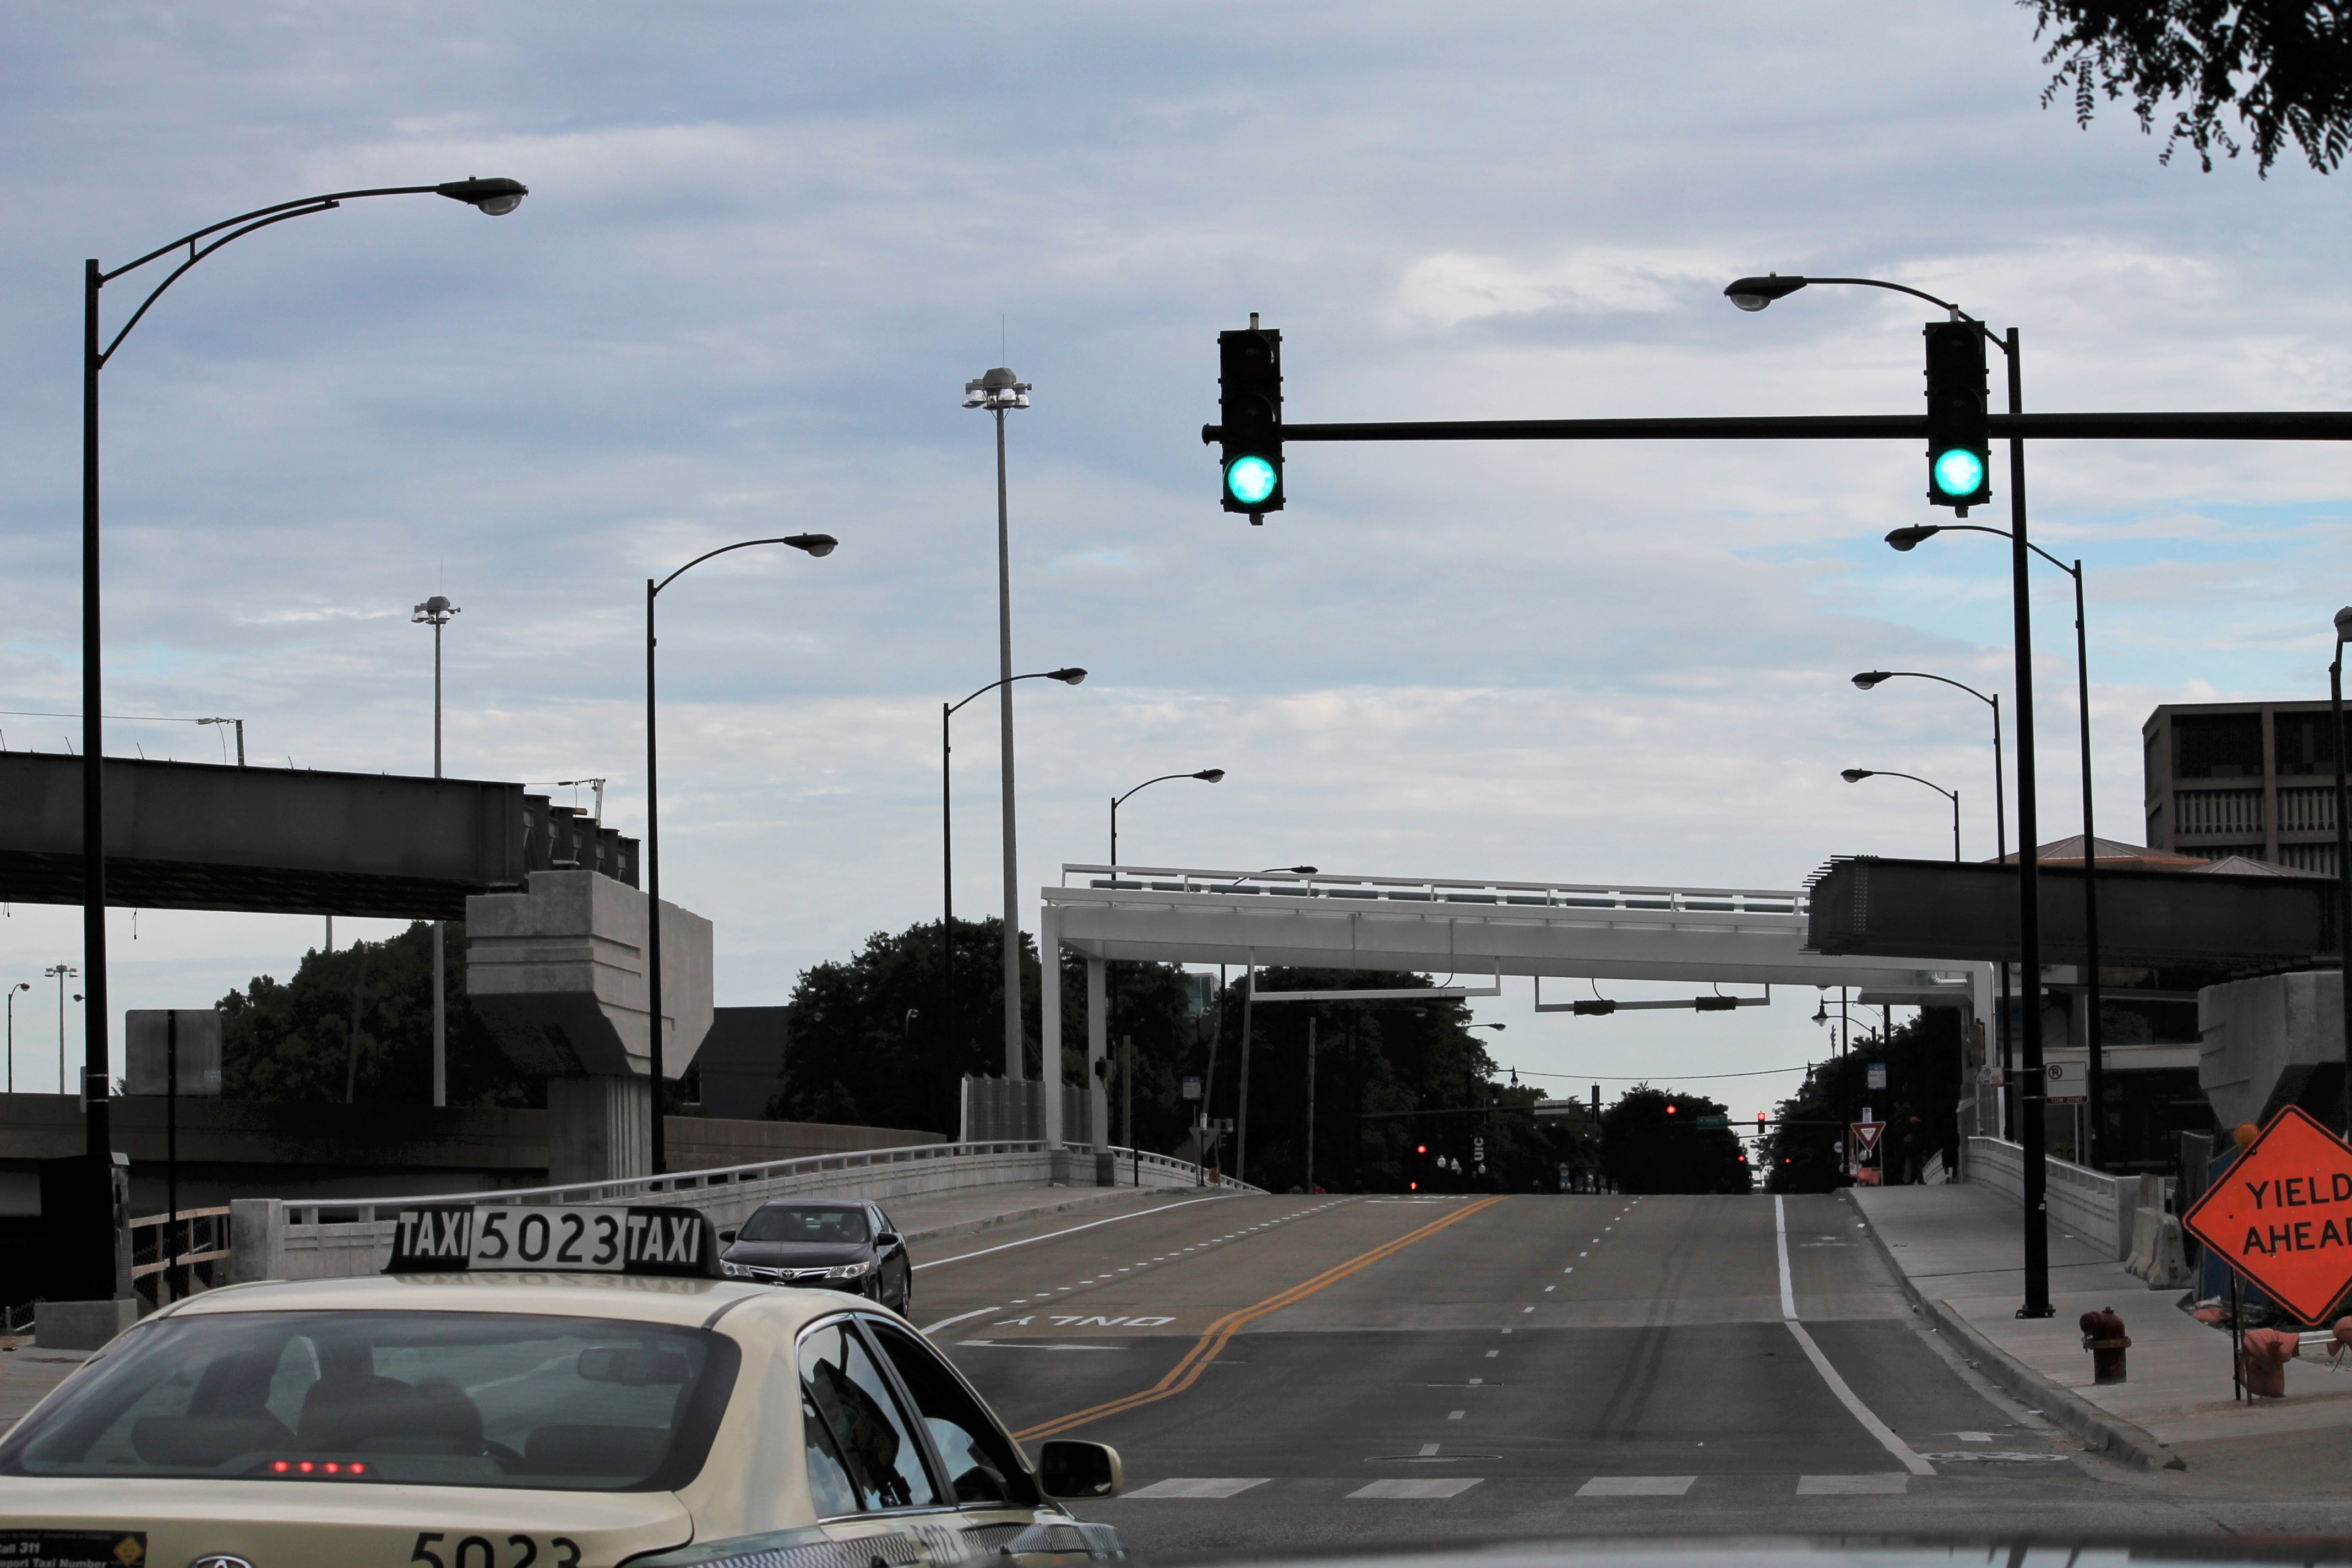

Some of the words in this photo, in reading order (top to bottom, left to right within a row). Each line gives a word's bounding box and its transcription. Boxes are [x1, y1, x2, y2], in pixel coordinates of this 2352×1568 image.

[1473, 1136, 1485, 1161] UIC
[2245, 1173, 2352, 1210] YIELD
[399, 1211, 471, 1257] TAXI
[477, 1212, 619, 1265] 5023
[627, 1215, 701, 1262] TAXI
[993, 1316, 1177, 1326] ONLY
[19, 1542, 40, 1554] 311
[31, 1558, 57, 1568] Taxi
[58, 1558, 107, 1568] Number
